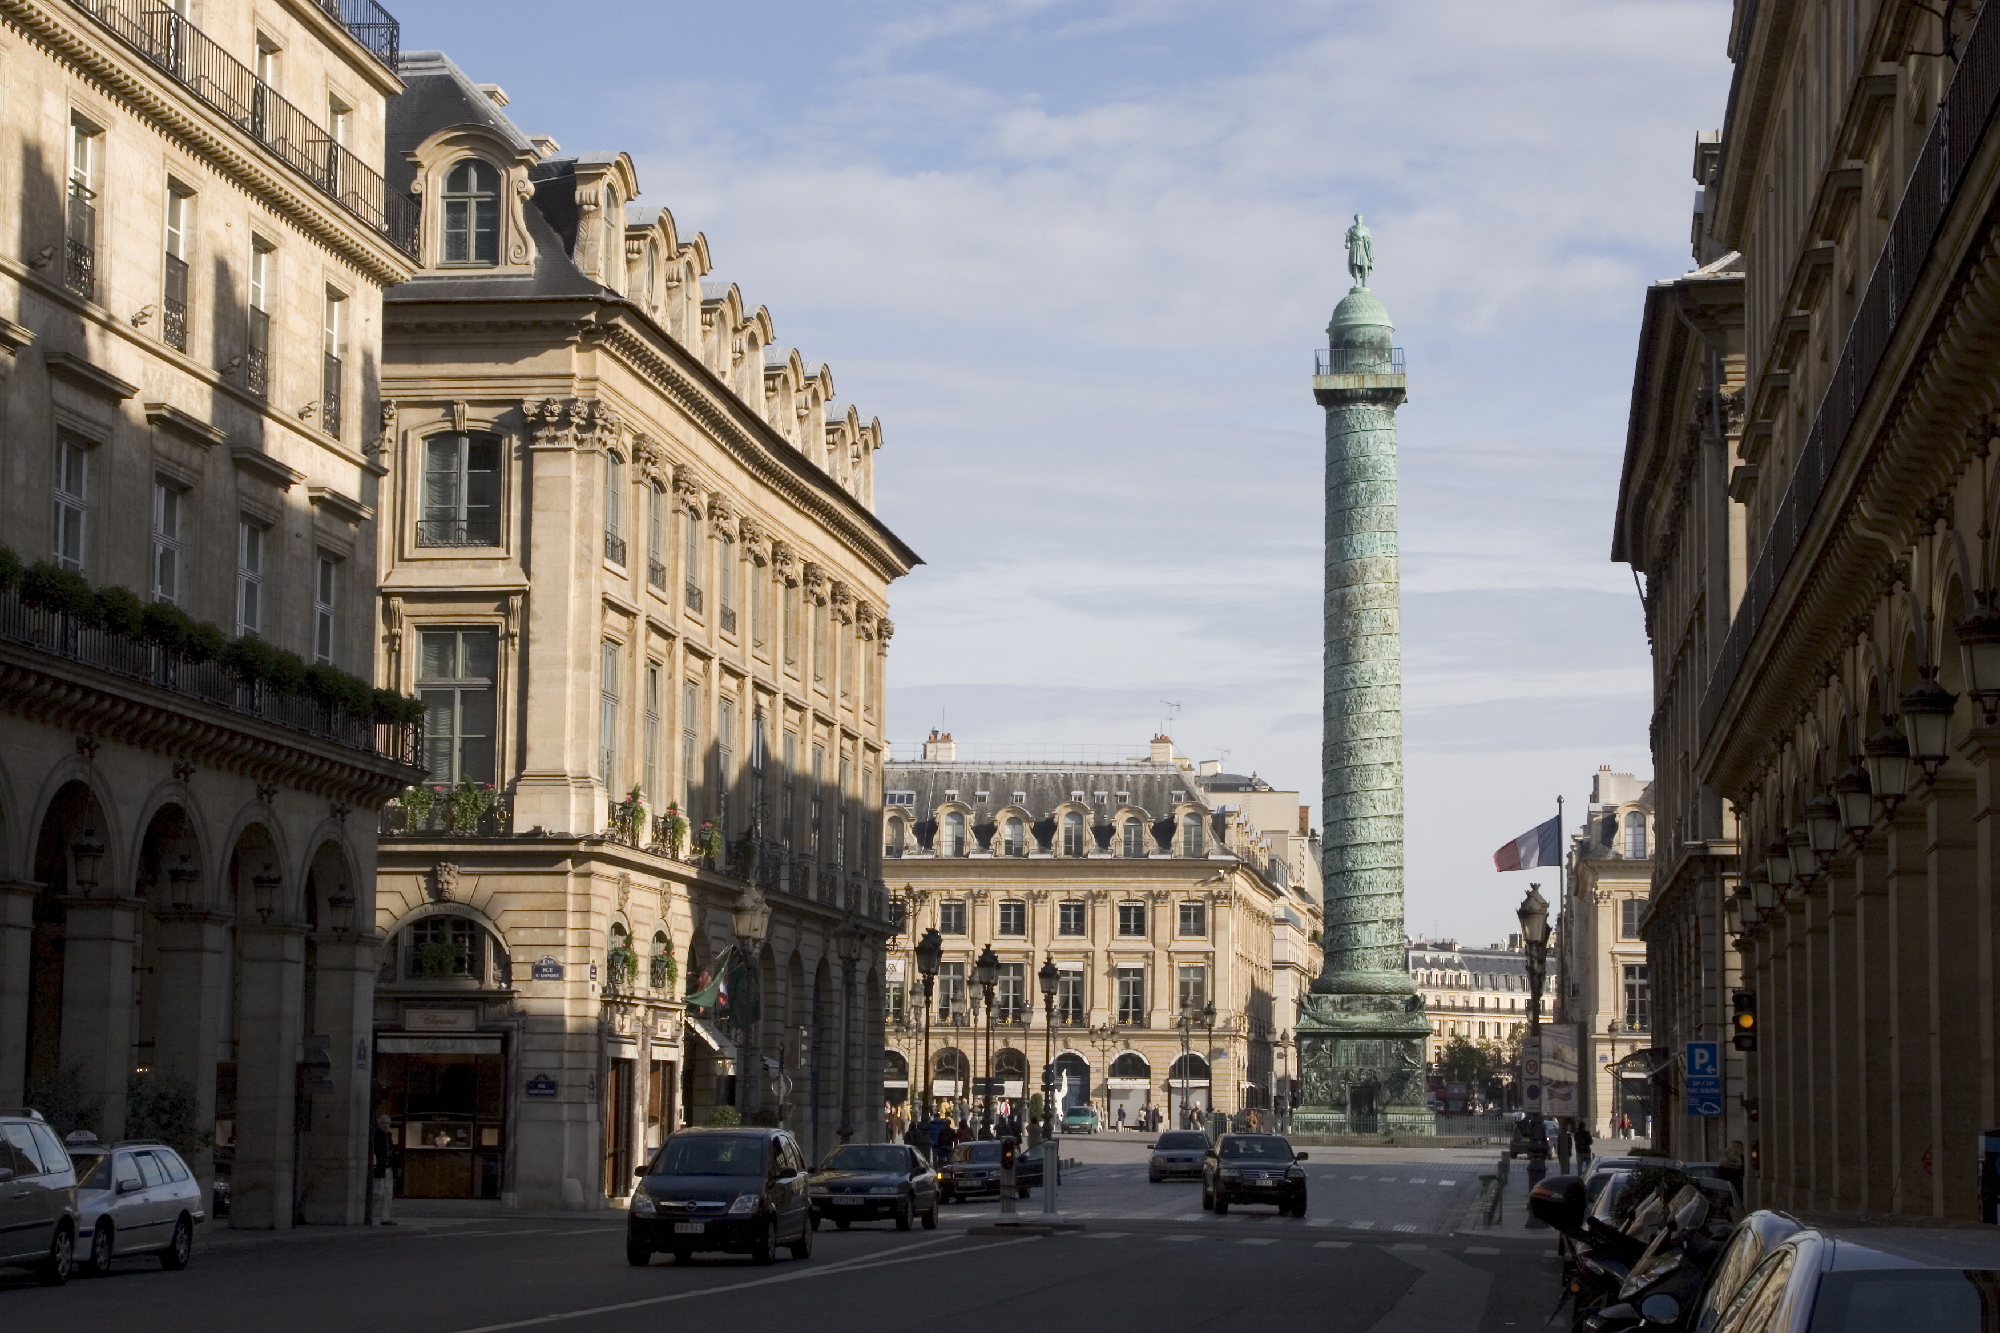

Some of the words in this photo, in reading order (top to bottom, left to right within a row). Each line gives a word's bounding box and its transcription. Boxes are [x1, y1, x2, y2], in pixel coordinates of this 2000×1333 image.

[419, 907, 430, 915] LE
[421, 1013, 460, 1027] Chopard
[1694, 1048, 1709, 1070] P
[1528, 1063, 1536, 1071] 30
